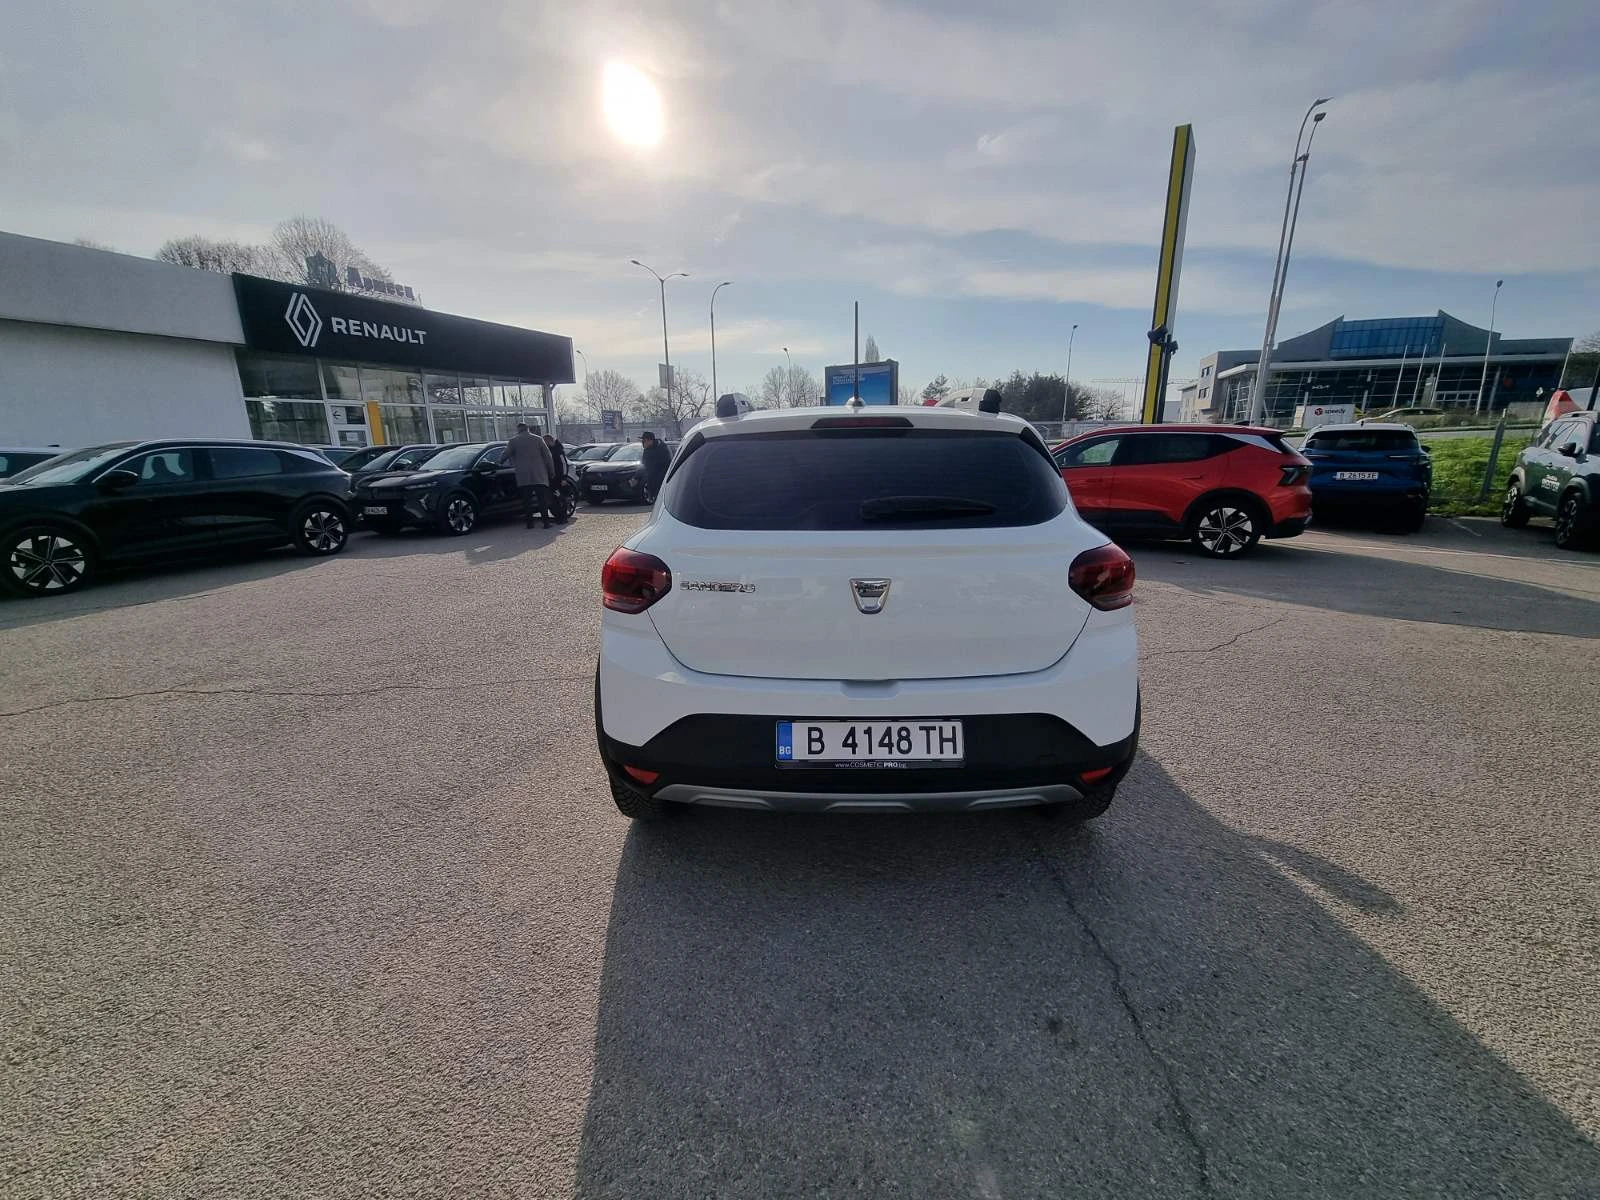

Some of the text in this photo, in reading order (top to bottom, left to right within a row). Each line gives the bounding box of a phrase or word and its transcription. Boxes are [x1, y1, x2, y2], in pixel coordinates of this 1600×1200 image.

[331, 316, 426, 345] RENAULT
[779, 746, 791, 755] BG
[807, 726, 958, 755] B 4148 TH
